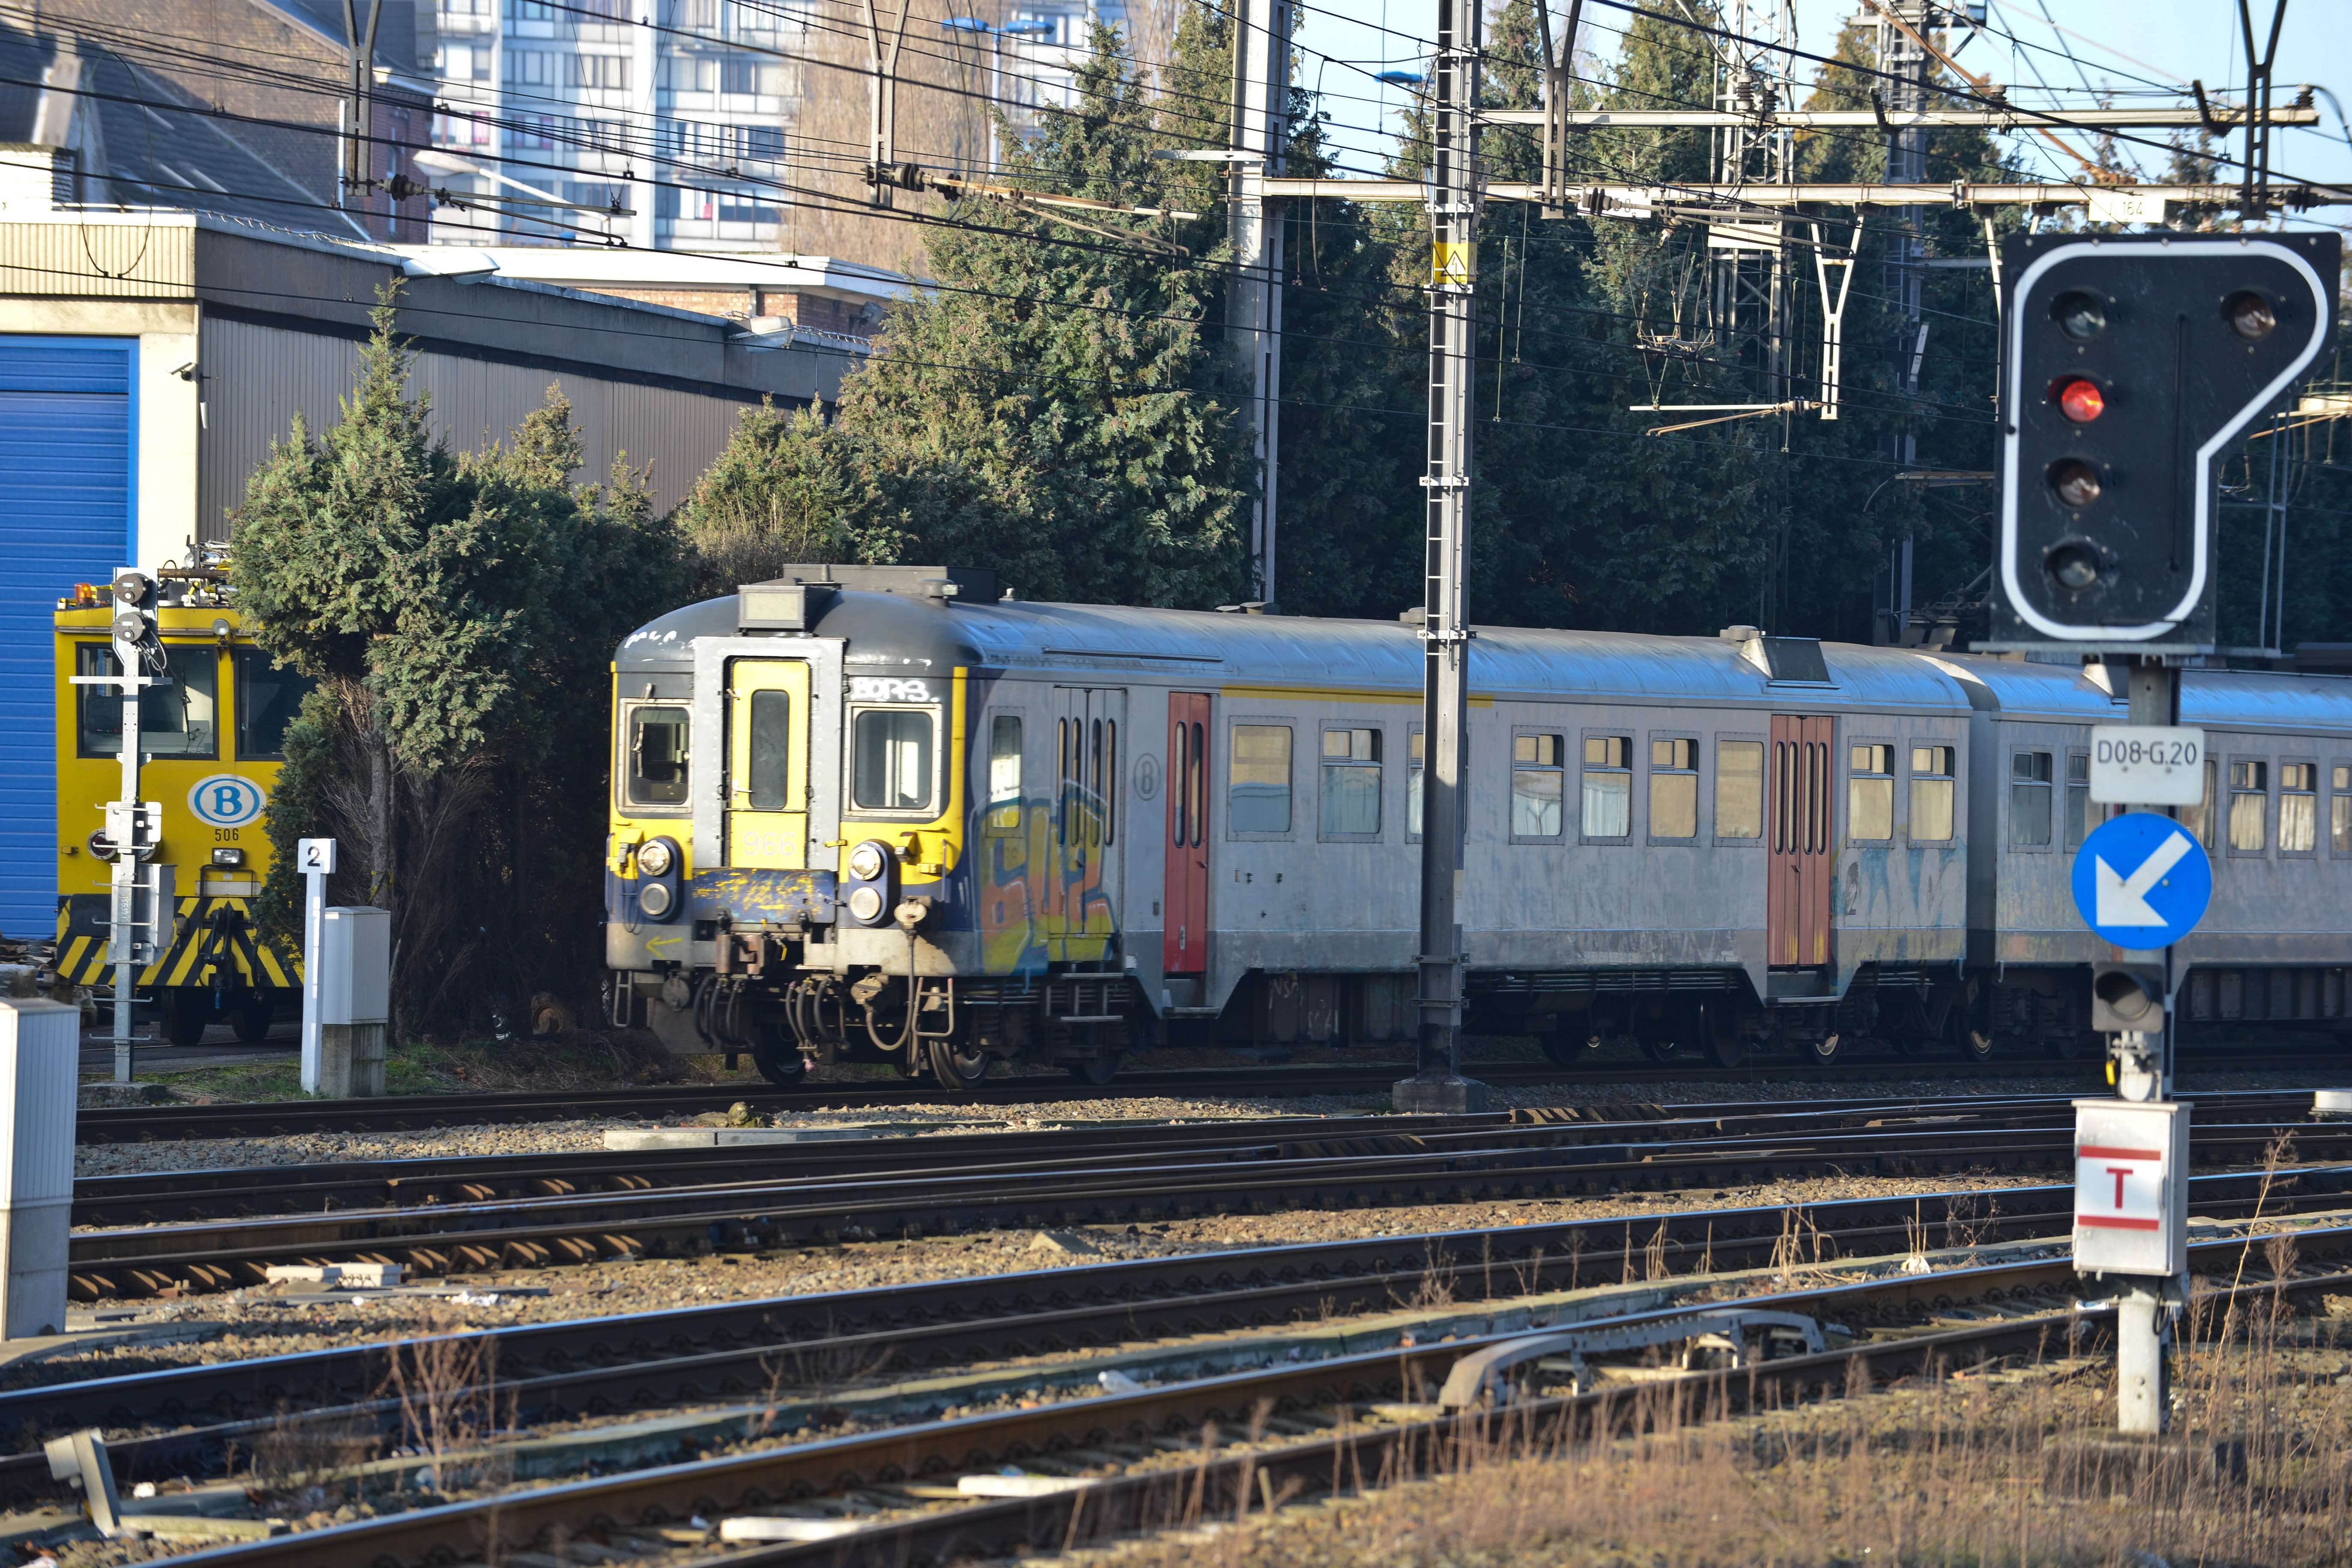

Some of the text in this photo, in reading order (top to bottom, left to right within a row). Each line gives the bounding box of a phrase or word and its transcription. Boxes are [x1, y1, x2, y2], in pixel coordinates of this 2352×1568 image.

[2123, 202, 2143, 215] 164
[2098, 739, 2197, 766] D08-G.20
[213, 786, 243, 816] B
[215, 829, 239, 841] 506
[744, 831, 796, 856] 966
[308, 846, 320, 867] 2
[2106, 1167, 2134, 1210] T
